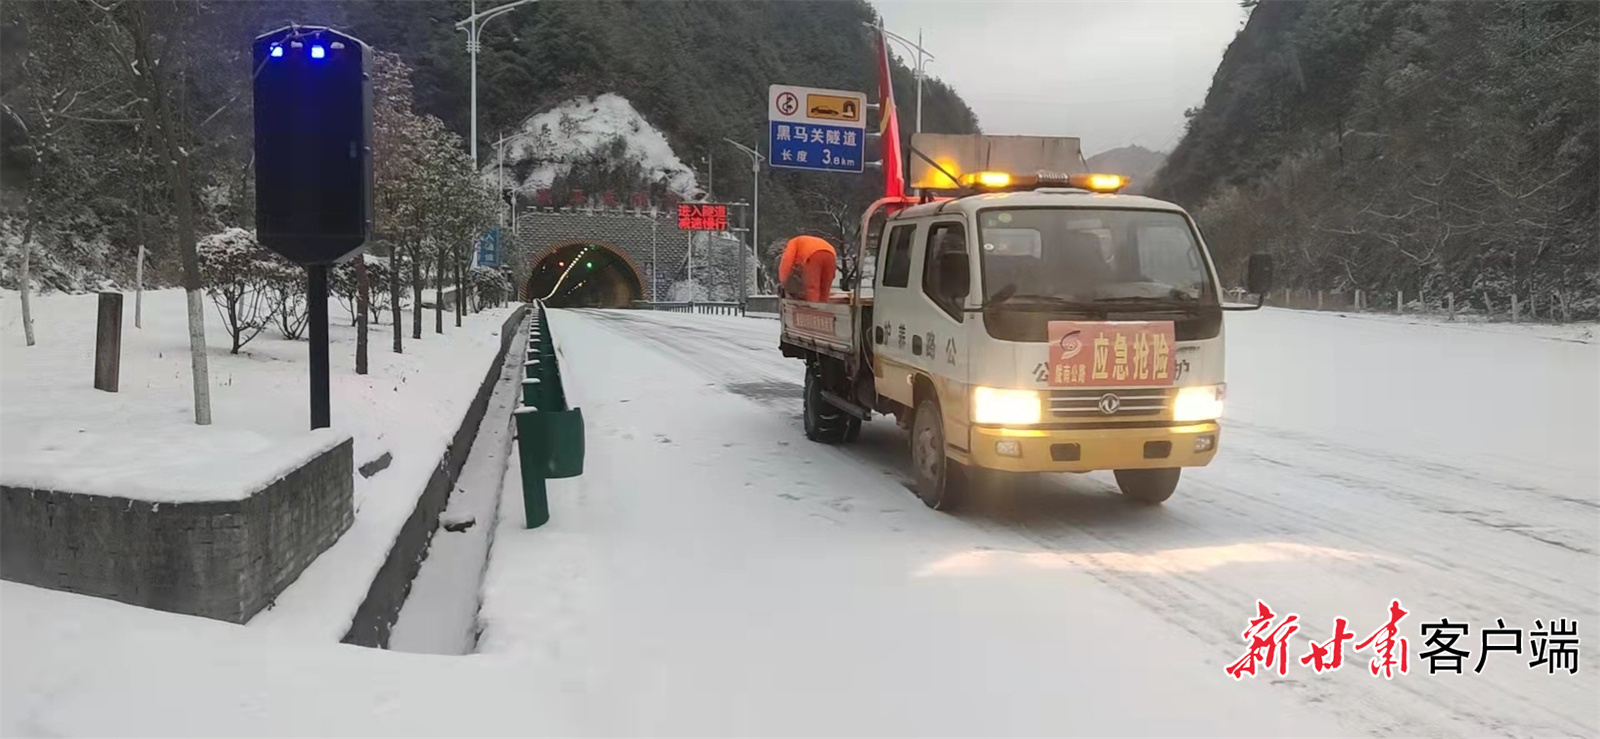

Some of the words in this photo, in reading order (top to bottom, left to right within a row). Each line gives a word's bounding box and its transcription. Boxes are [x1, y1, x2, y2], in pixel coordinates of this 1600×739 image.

[776, 124, 857, 147] 黑马关隧道
[781, 149, 808, 163] 长度
[822, 149, 855, 167] 3.8km
[678, 204, 726, 217] 进入隧道
[1092, 332, 1170, 381] 应急抢险
[1055, 363, 1087, 384] 陇南公路
